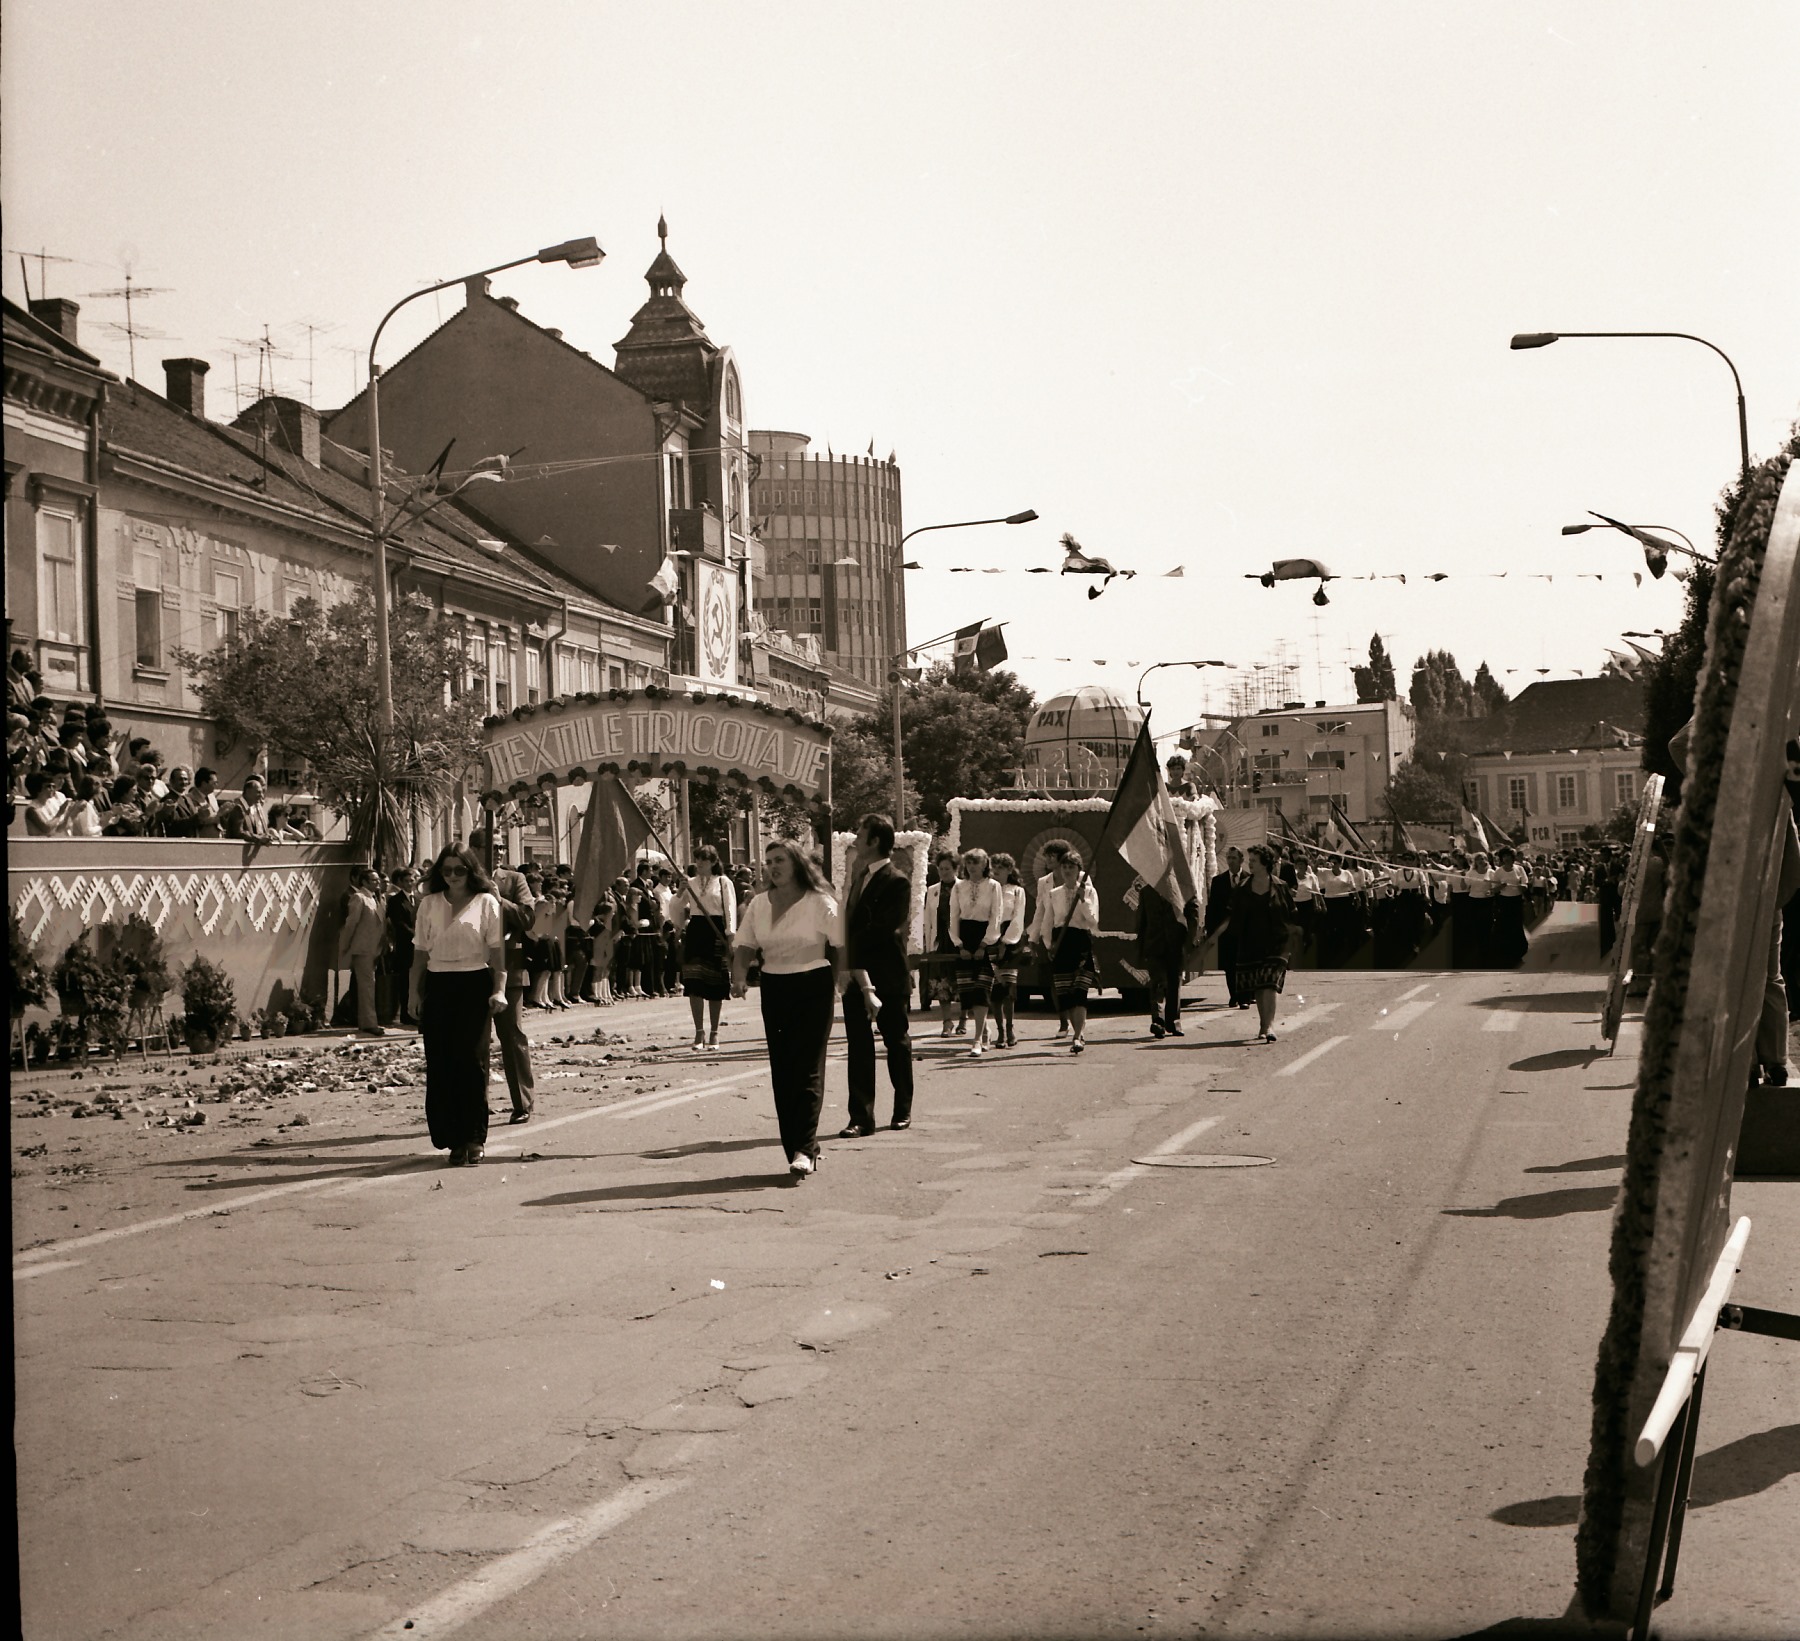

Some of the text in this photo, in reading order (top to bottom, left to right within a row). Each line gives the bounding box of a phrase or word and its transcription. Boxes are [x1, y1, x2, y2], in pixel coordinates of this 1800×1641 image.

[1037, 710, 1066, 728] PAX
[482, 709, 830, 790] TEXTILE TRICOTAJE
[1532, 827, 1550, 841] PCR
